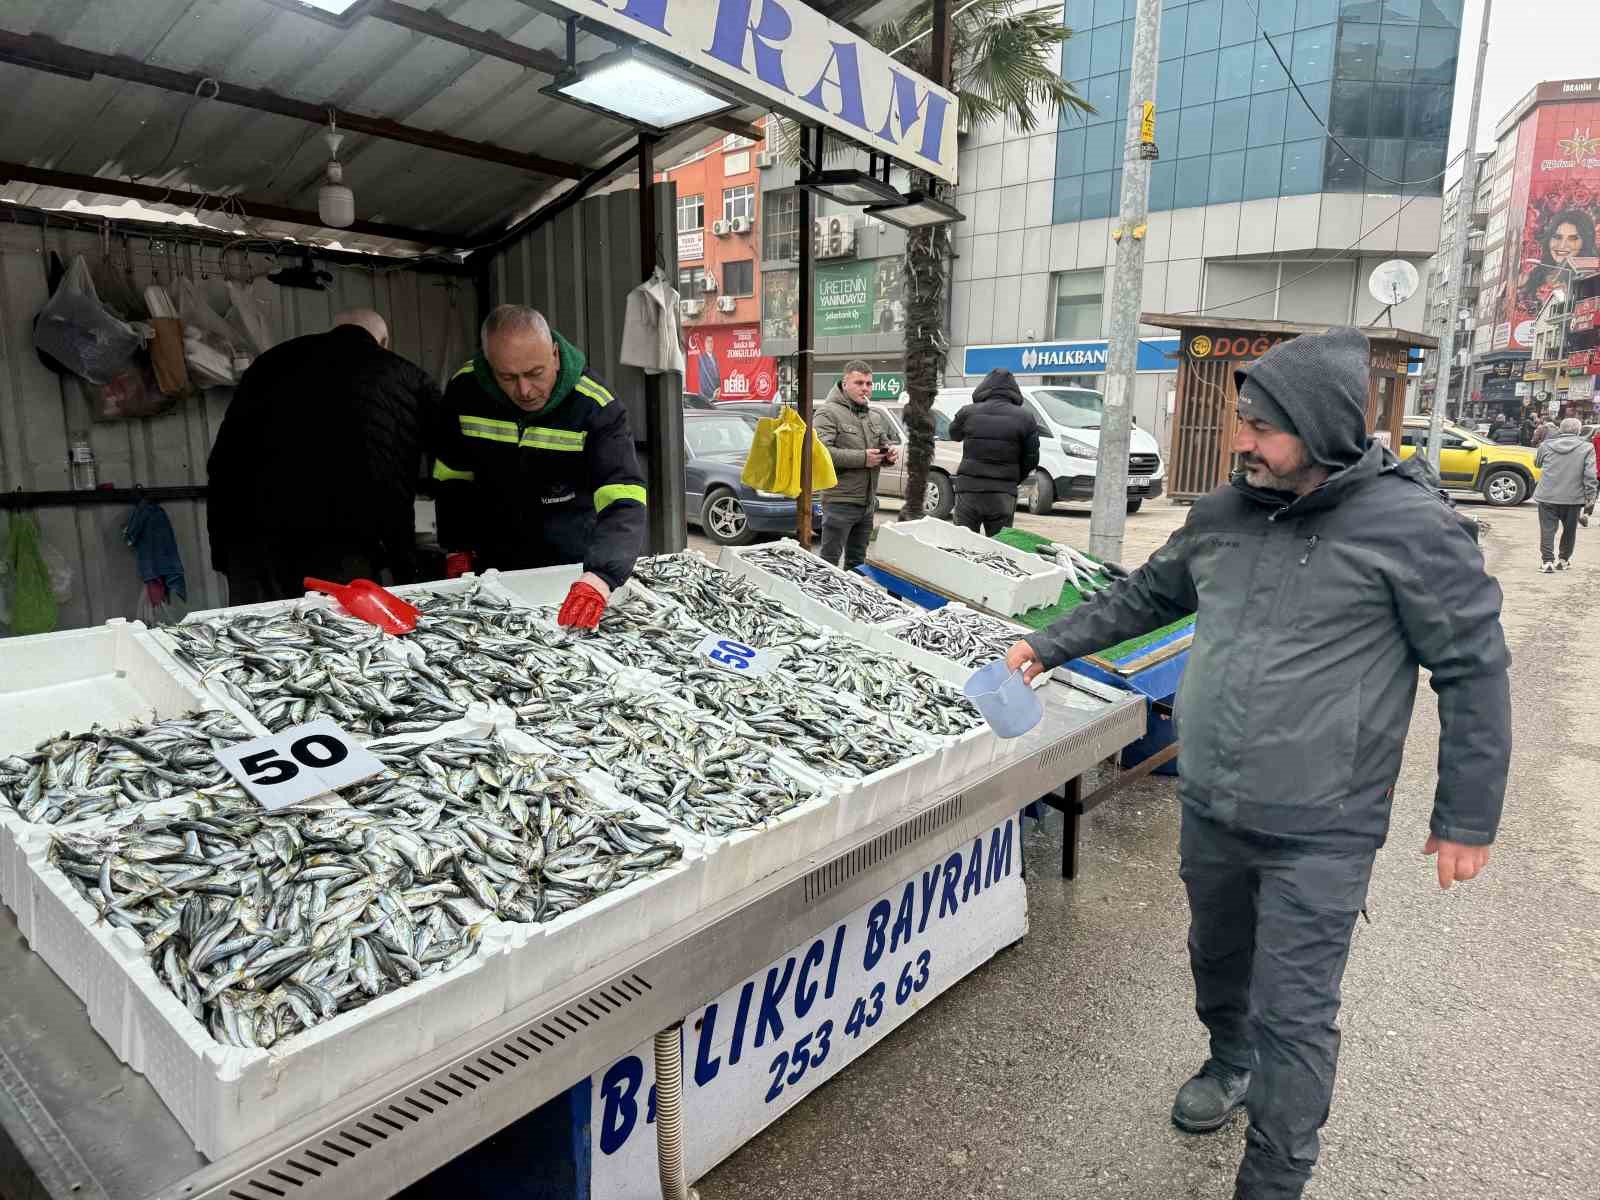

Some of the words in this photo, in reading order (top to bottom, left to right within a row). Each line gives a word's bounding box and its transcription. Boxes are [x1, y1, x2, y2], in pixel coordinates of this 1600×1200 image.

[1038, 350, 1109, 365] HALKBAN
[709, 640, 756, 669] 50
[239, 734, 349, 785] 50
[600, 924, 847, 1156] BLIKCI
[863, 818, 1013, 971] BAYRAM
[765, 1019, 834, 1104] 253
[844, 981, 886, 1039] 43
[895, 949, 931, 1006] 63
